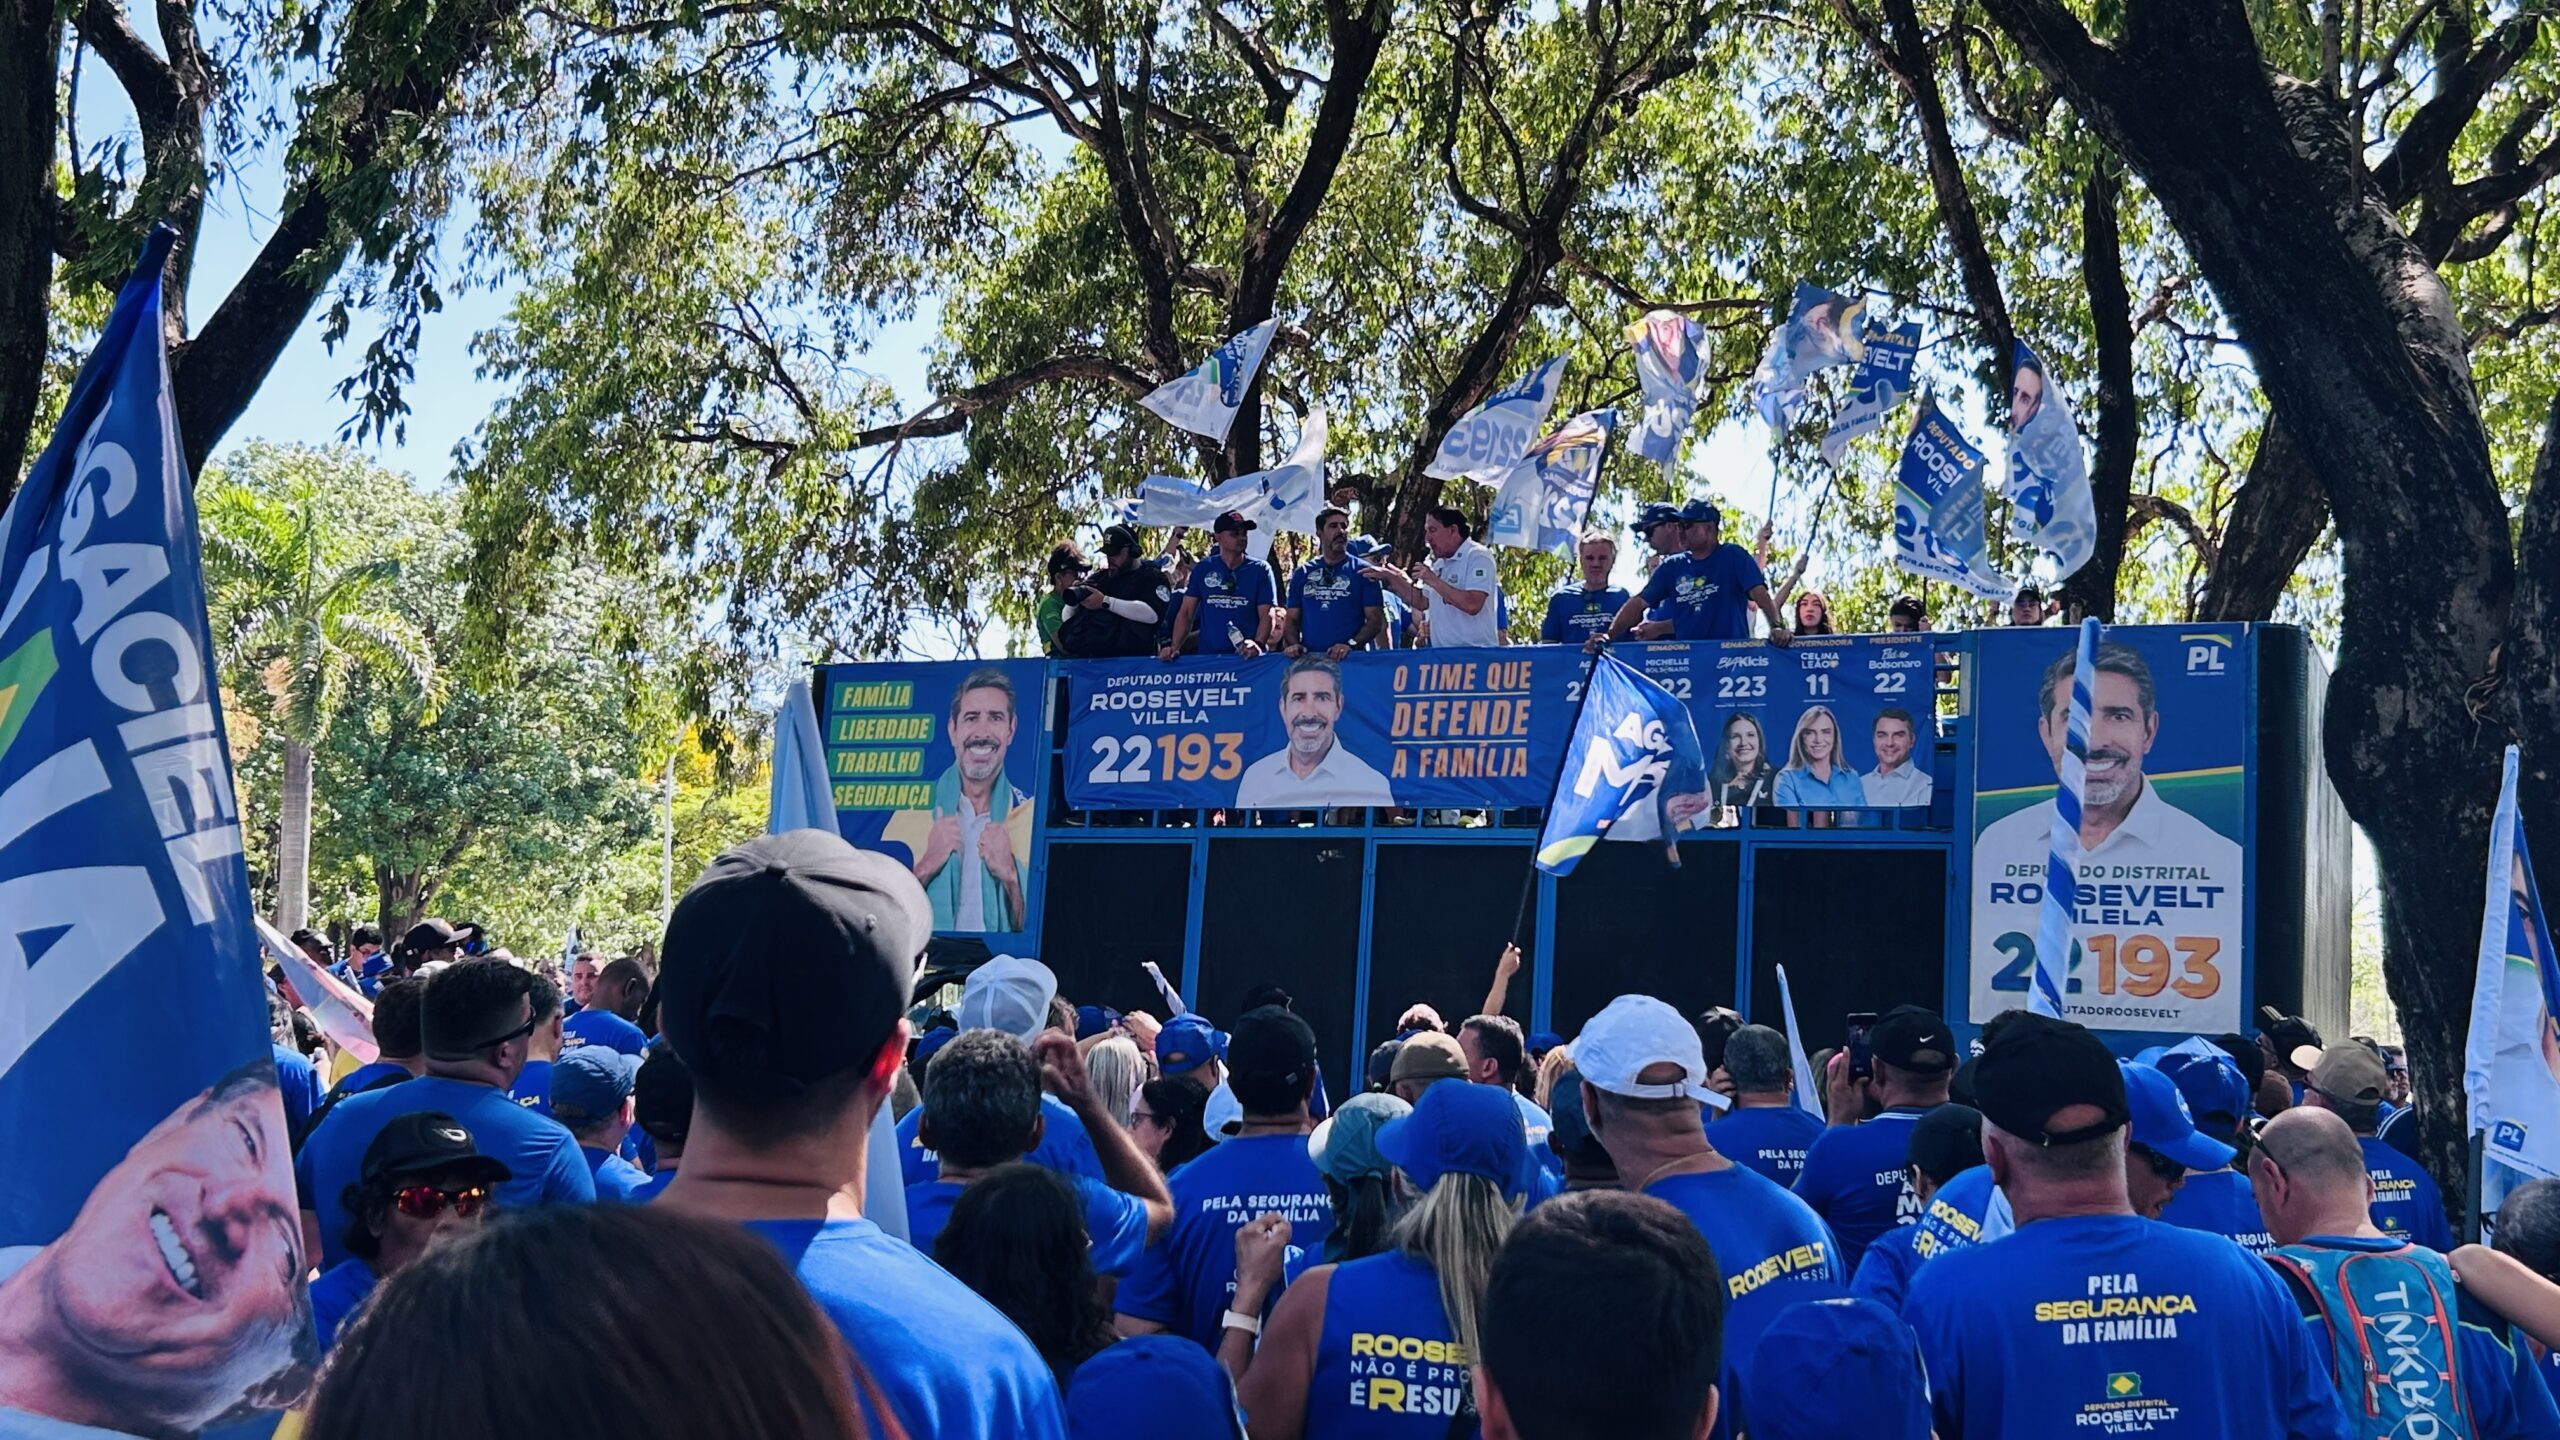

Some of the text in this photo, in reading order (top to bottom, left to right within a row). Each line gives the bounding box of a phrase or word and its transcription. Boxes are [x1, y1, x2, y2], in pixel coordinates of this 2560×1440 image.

[1926, 420, 1975, 470] DEPUTADO
[1721, 641, 1766, 649] SENADORA
[1869, 636, 1922, 644] PRESIDENTE
[58, 393, 243, 926] GACIEL
[1645, 658, 1689, 666] MICHELLE
[1800, 652, 1839, 660] CELINA
[1802, 659, 1830, 669] LEÃO
[1868, 660, 1922, 670] Bolsonaro
[2187, 646, 2225, 670] PL
[1107, 672, 1238, 688] DEPUTADO DISTRITAL
[1393, 661, 1532, 692] O TIME QUE
[1806, 673, 1829, 696] 11
[1873, 672, 1906, 693] 22
[842, 682, 911, 708] FAMÍLIA
[1718, 676, 1767, 698] 223
[1090, 687, 1252, 711] ROOSEVELT
[1131, 710, 1209, 725] VILELA
[1390, 699, 1531, 737] DEFENDE
[839, 718, 930, 741] LIBERDADE
[835, 752, 920, 773] TRABALHO
[1391, 741, 1528, 778] A FAMÍLIA
[834, 784, 930, 809] SEGURANÇA
[2005, 864, 2211, 880] DEPUDO DISTRITAL
[1990, 882, 2224, 909] ROSEVELT
[2072, 908, 2164, 926] ILELA
[2498, 1125, 2521, 1143] PL
[1758, 1149, 1809, 1159] PELA SEG
[1777, 1160, 1790, 1169] DA
[1876, 1169, 1907, 1185] DEPU
[2371, 1169, 2392, 1180] PELA
[1202, 1195, 1242, 1212] PELA
[1227, 1206, 1320, 1223] DA FMÍLIA
[2088, 1273, 2138, 1295] PELA
[2034, 1295, 2197, 1321] SEGURANÇA
[2062, 1316, 2177, 1344] DA FAMÍLIA
[1350, 1357, 1395, 1376] NÃO
[1406, 1361, 1417, 1378] É
[1350, 1379, 1366, 1406] É
[2084, 1399, 2169, 1411] DEPUTADO DISTRITAL
[2076, 1408, 2179, 1426] ROOSEVELT
[2105, 1422, 2154, 1434] VILELA
